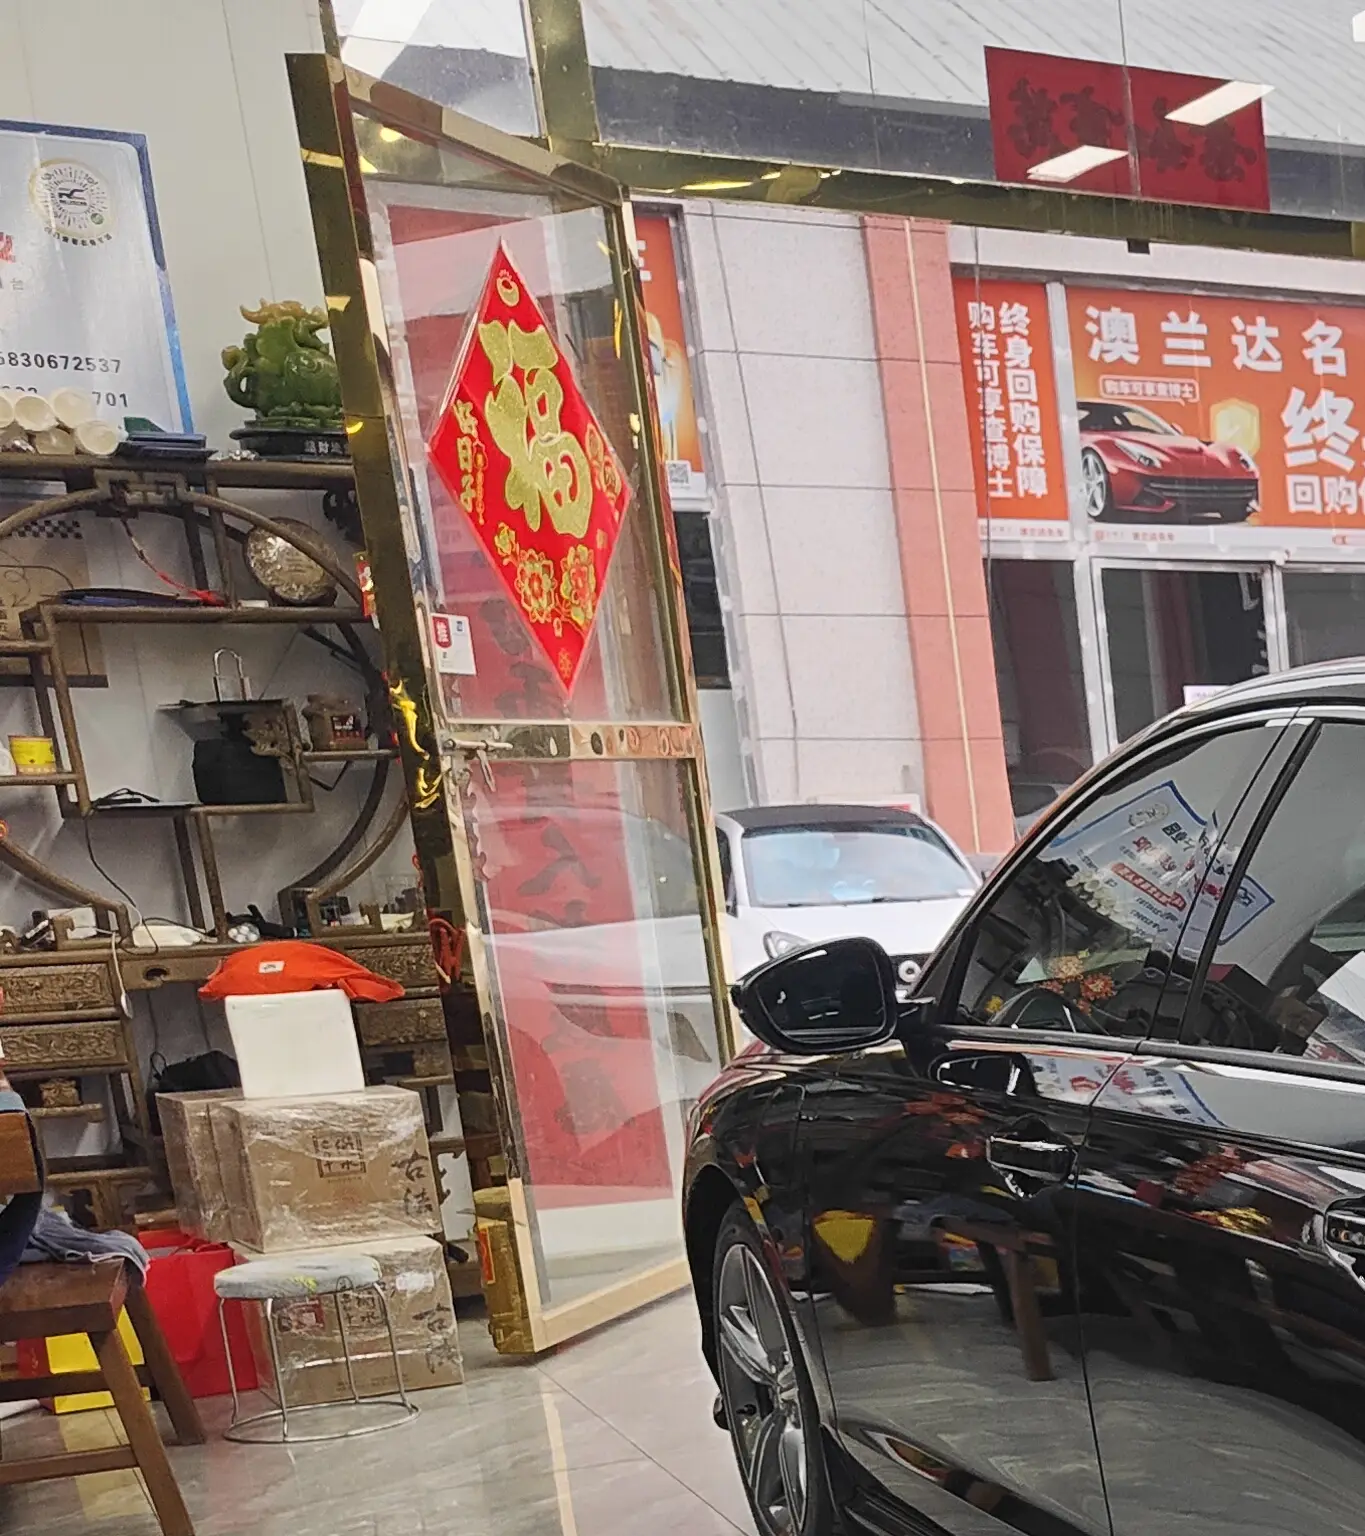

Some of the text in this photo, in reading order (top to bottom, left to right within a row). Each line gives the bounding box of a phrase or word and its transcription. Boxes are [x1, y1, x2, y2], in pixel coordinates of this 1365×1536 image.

[453, 399, 478, 513] 好日子
[478, 318, 593, 539] 福
[968, 301, 1013, 499] 购车可享查博士
[1000, 301, 1048, 498] 终身回购保障
